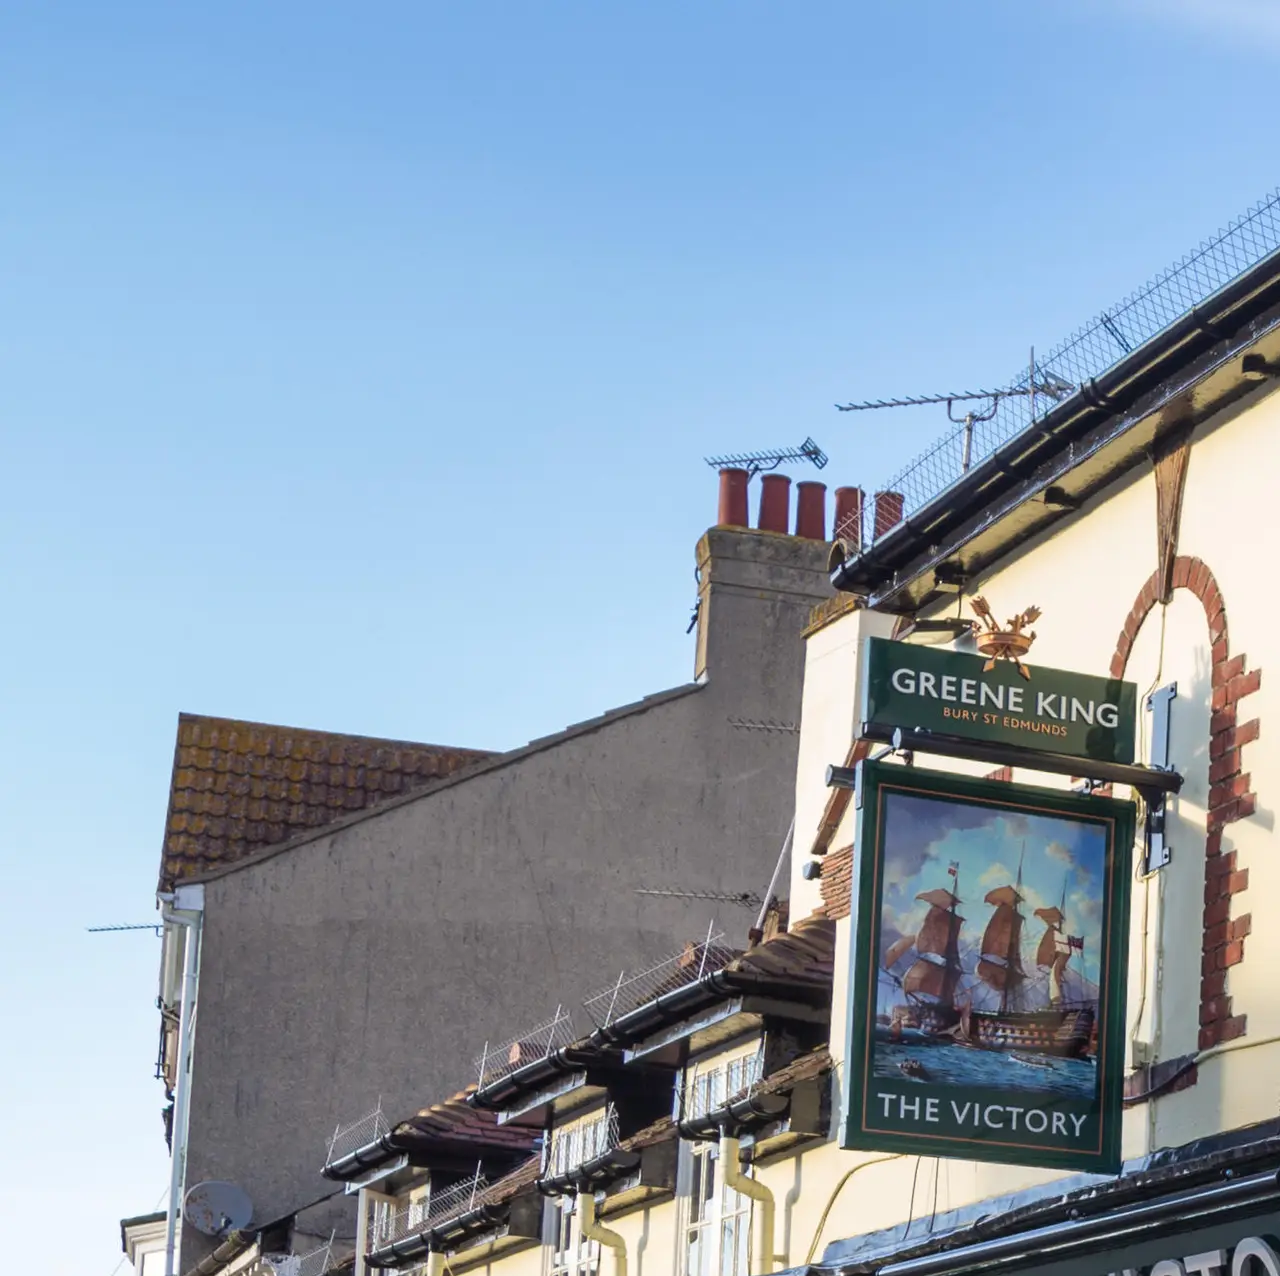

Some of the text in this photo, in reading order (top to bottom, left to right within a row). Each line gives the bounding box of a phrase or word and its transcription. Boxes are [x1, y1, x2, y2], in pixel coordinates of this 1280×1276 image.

[891, 667, 1120, 729] GREENE KING
[943, 705, 1068, 737] BURY ST EDMUNDS
[877, 1093, 1087, 1137] THE VICTORY
